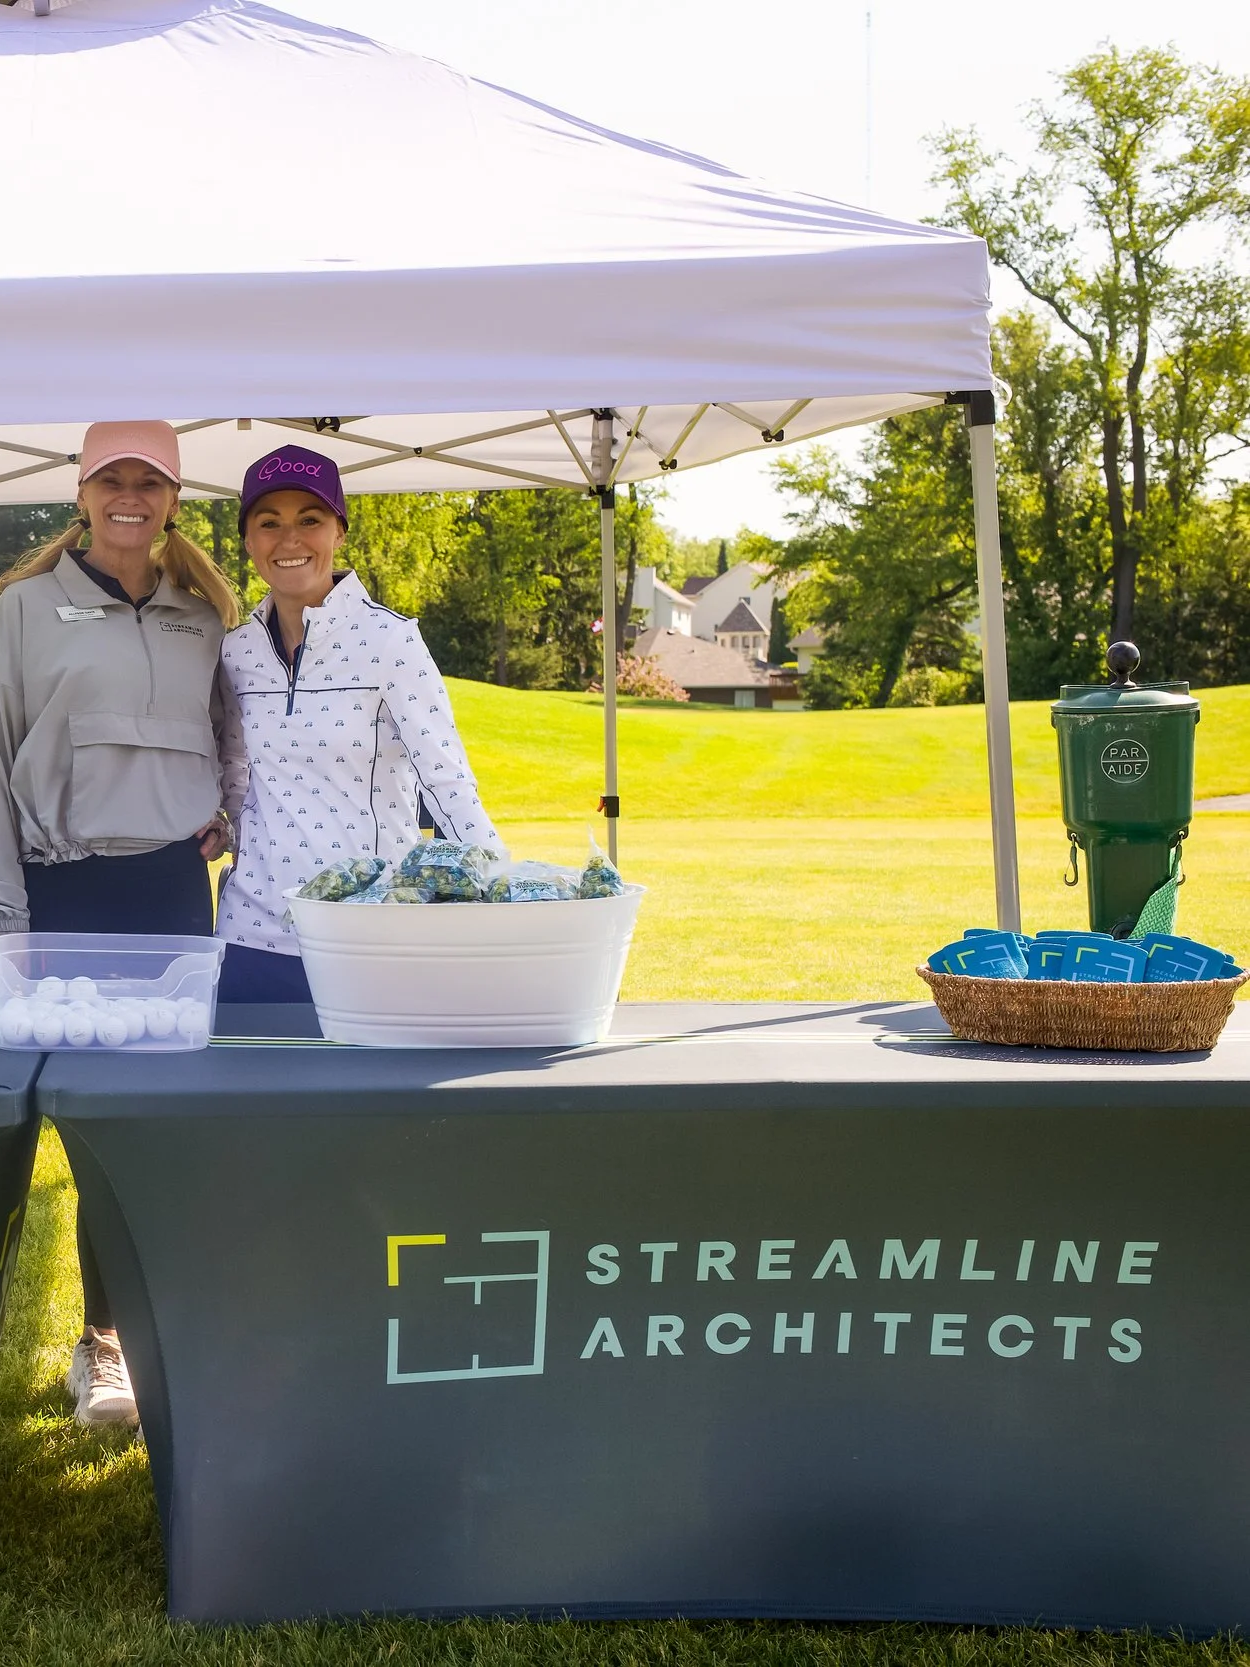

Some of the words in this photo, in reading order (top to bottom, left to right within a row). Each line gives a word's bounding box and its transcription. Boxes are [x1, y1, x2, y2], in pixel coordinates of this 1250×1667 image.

[258, 457, 322, 481] Good
[1109, 747, 1140, 758] PAR
[1107, 763, 1142, 775] AIDE
[585, 1238, 1161, 1286] STREAMLINE
[579, 1311, 1144, 1364] ARCHITECTS
